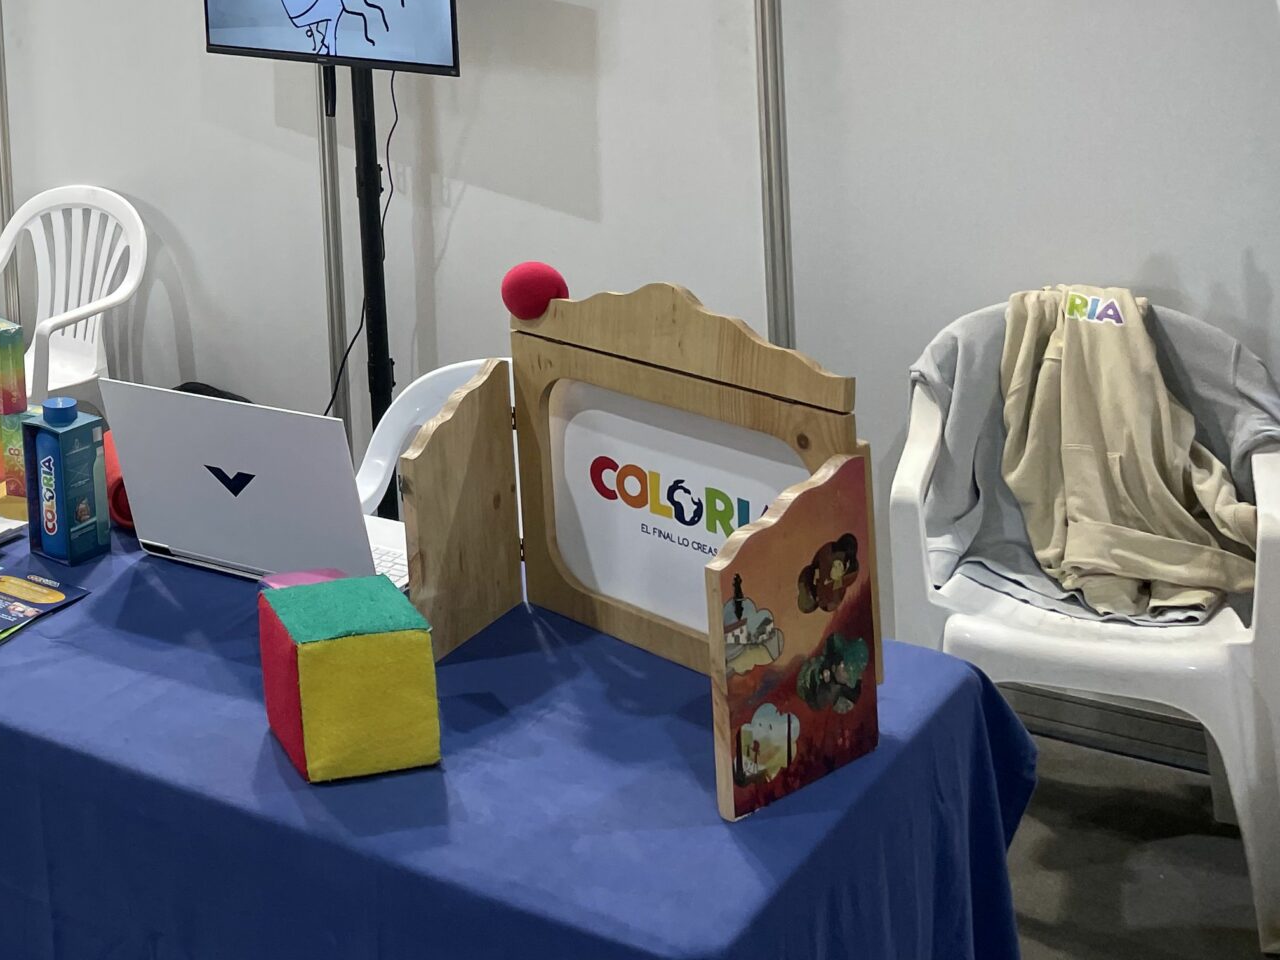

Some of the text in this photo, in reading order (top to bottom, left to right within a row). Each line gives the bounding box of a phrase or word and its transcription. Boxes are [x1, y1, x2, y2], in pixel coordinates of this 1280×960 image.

[40, 456, 58, 535] COLORIA
[590, 456, 768, 538] COLORI
[640, 522, 718, 557] EL FINAL LO CREAS
